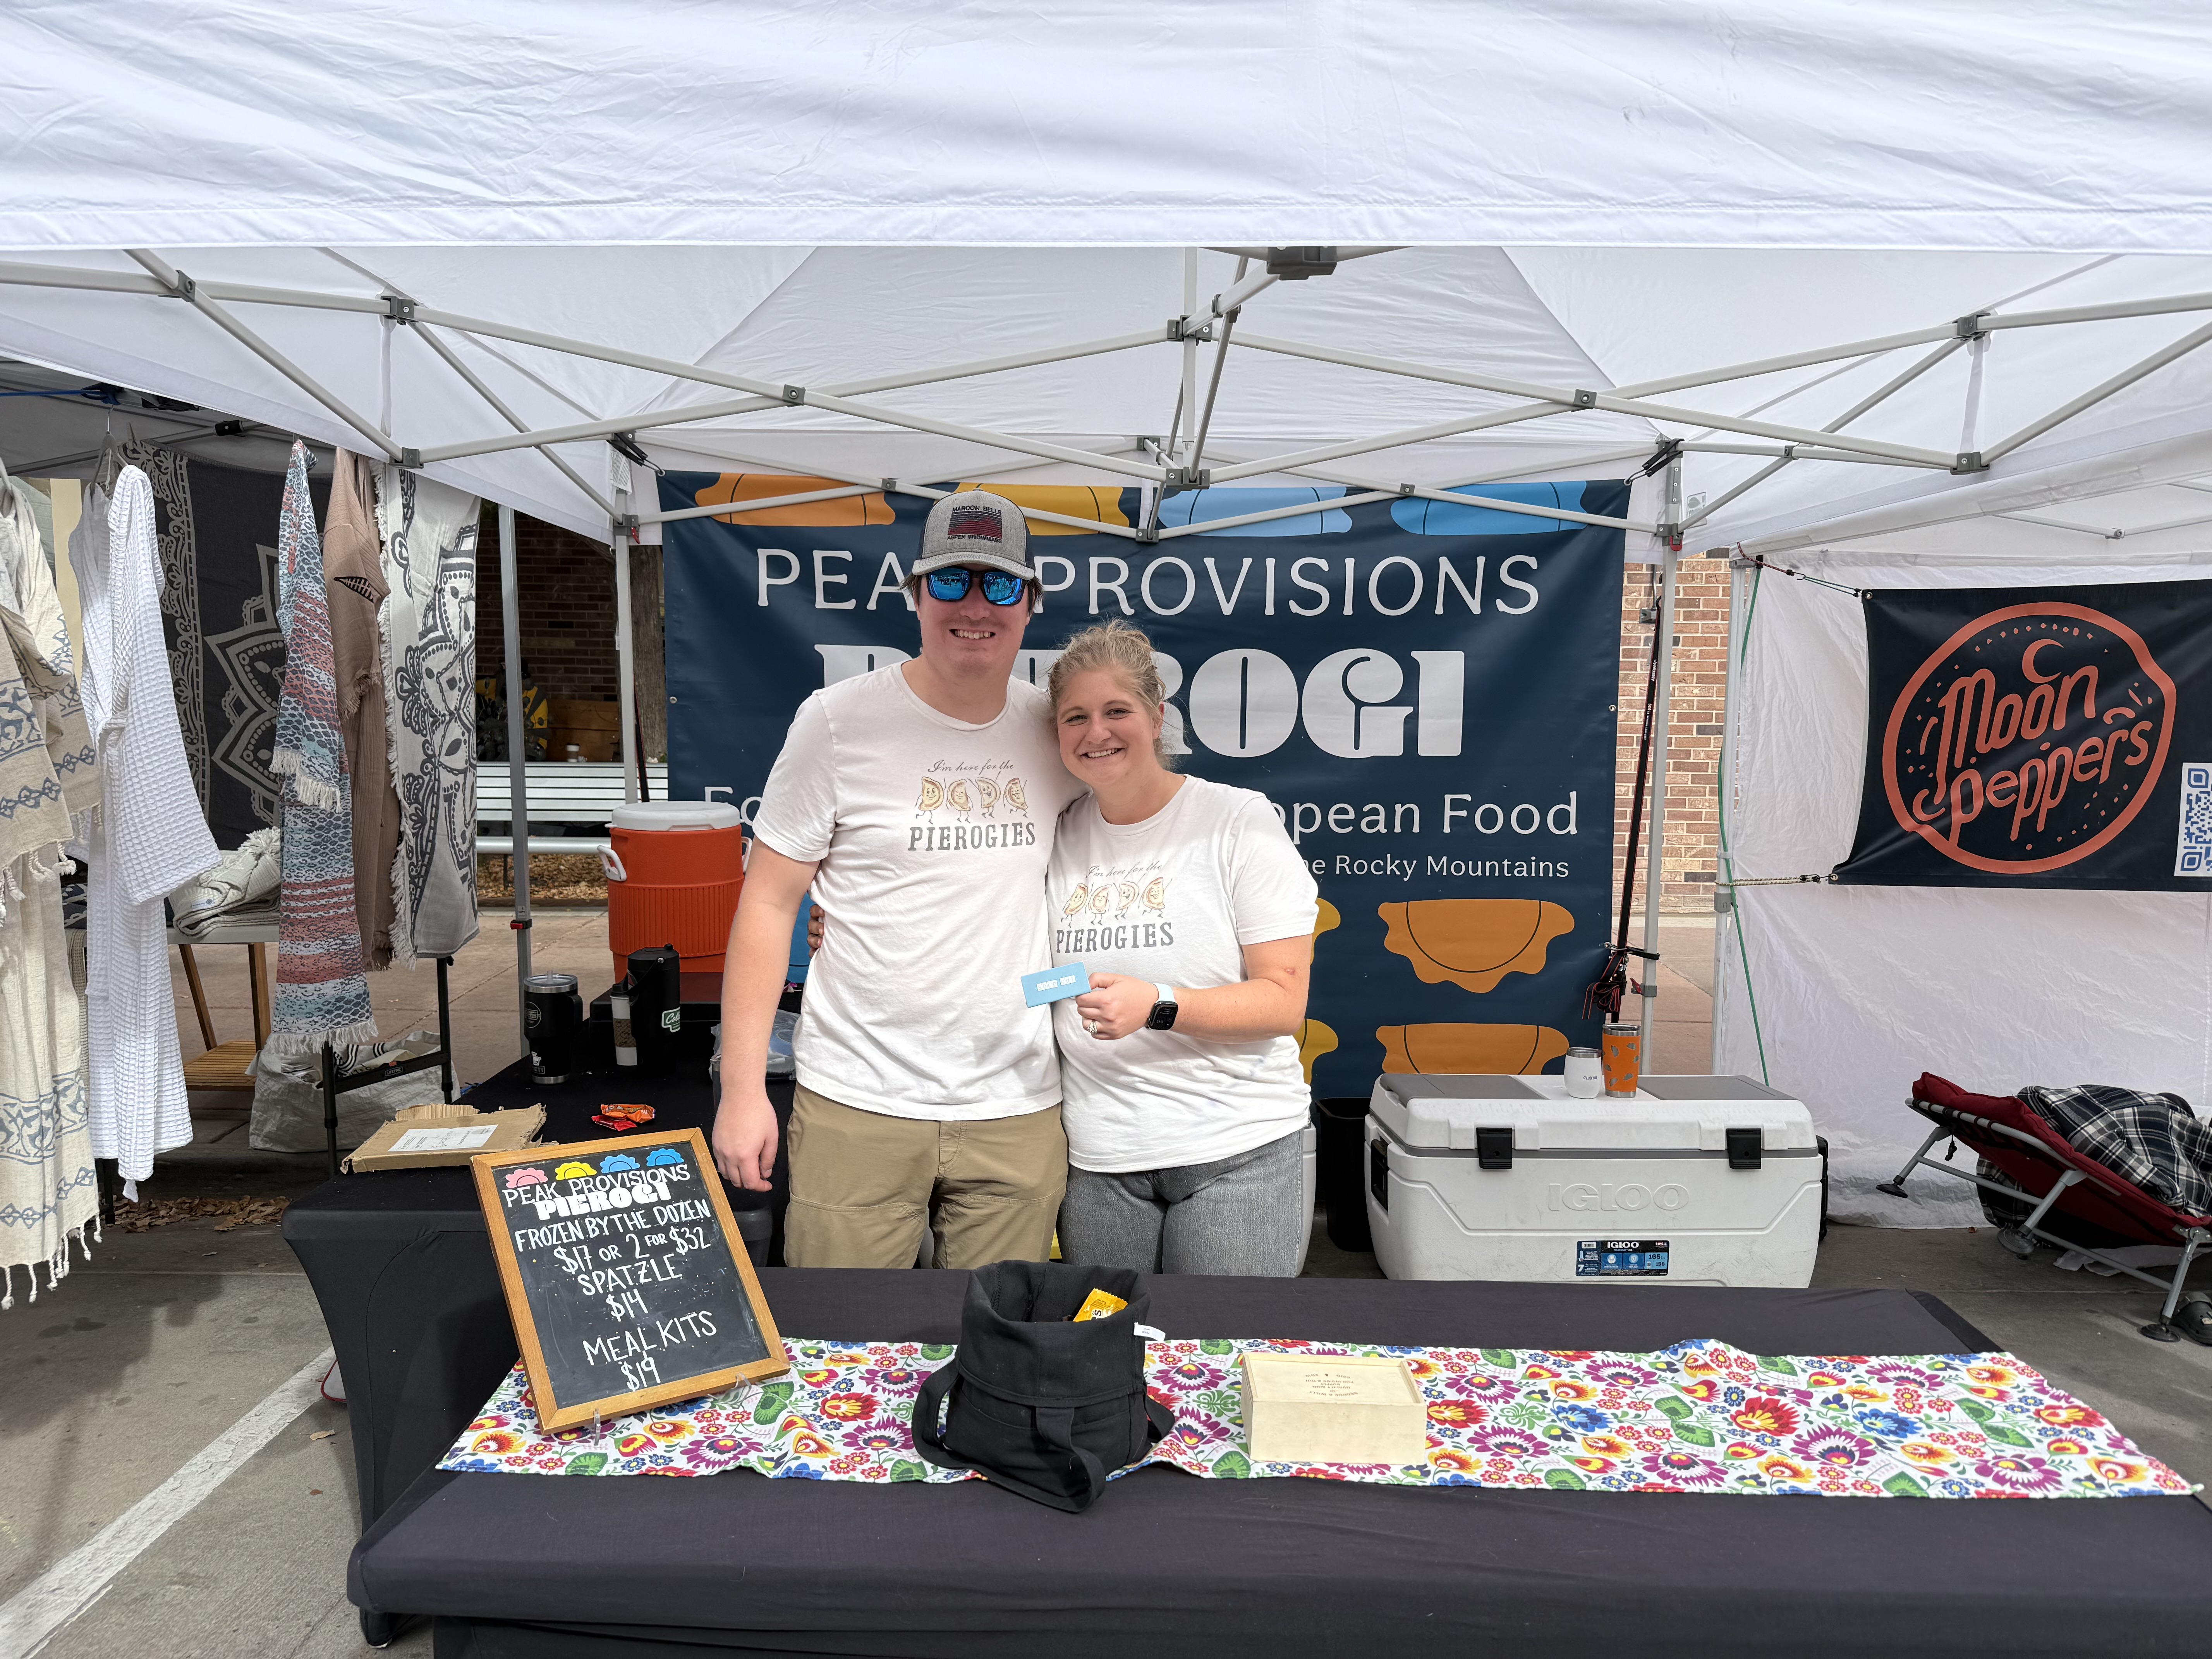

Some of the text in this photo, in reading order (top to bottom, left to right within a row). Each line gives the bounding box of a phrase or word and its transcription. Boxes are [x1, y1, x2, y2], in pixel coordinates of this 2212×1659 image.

[983, 506, 1001, 515] BELLS
[968, 534, 1002, 544] SNOWMASS
[757, 548, 1539, 616] PEA PROVISIONS
[1933, 665, 2099, 805] Moon
[955, 762, 978, 771] here
[979, 759, 997, 775] for
[999, 760, 1014, 770] the
[1949, 720, 2154, 848] peppers
[1443, 791, 1578, 835] Food
[908, 822, 1036, 851] PIEROGIES
[1123, 861, 1144, 879] for
[1146, 860, 1163, 871] the
[1335, 854, 1417, 881] Rocky
[1427, 856, 1569, 878] Mountains
[1056, 922, 1174, 953] PIEROGIES
[502, 1164, 690, 1207] PEAK PROVISIONS
[532, 1182, 672, 1221] PIEROGI
[1548, 1183, 1690, 1211] IGLOO
[515, 1199, 711, 1252] FROZEN BY THE DOZEN
[553, 1226, 711, 1274] $17 OR 2 FOR $32
[577, 1253, 683, 1296] SPATZLE
[605, 1288, 649, 1322] $14
[582, 1310, 717, 1365] MEAL KITS
[620, 1350, 661, 1392] $19
